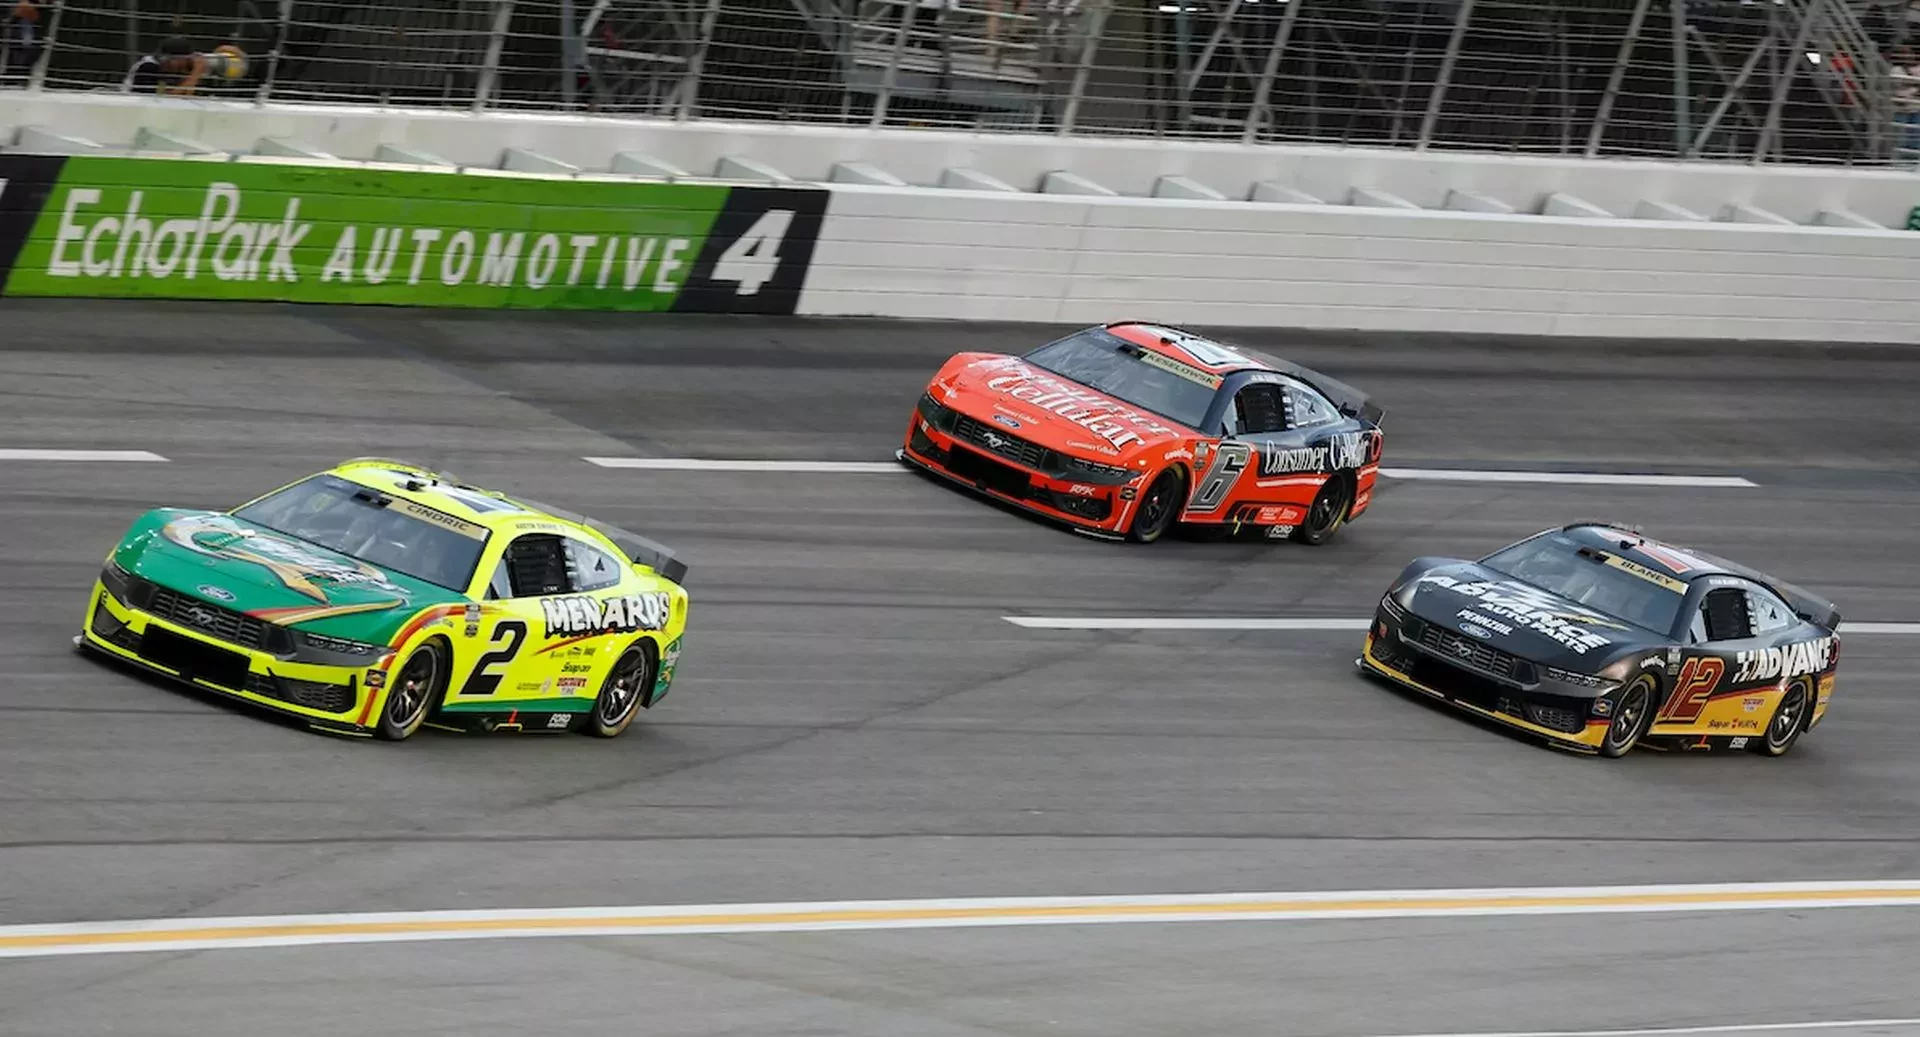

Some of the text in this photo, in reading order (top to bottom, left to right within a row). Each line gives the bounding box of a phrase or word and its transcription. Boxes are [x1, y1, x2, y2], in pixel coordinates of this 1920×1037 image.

[48, 182, 689, 292] EchoPark AUTOMOTIVE
[712, 210, 794, 296] 4
[1187, 440, 1251, 513] 6
[1265, 440, 1328, 473] Consumer
[407, 504, 471, 531] CINDRIC
[1621, 561, 1672, 585] BLANEY
[541, 592, 670, 637] MENARDS
[1419, 576, 1612, 649] ADVANCE
[1456, 609, 1514, 636] PENNZOIL
[1459, 622, 1493, 640] Ford
[1479, 602, 1590, 656] AUTO PARTS
[460, 621, 527, 694] 2
[1750, 637, 1832, 681] ADVANCE
[1661, 657, 1725, 721] 12
